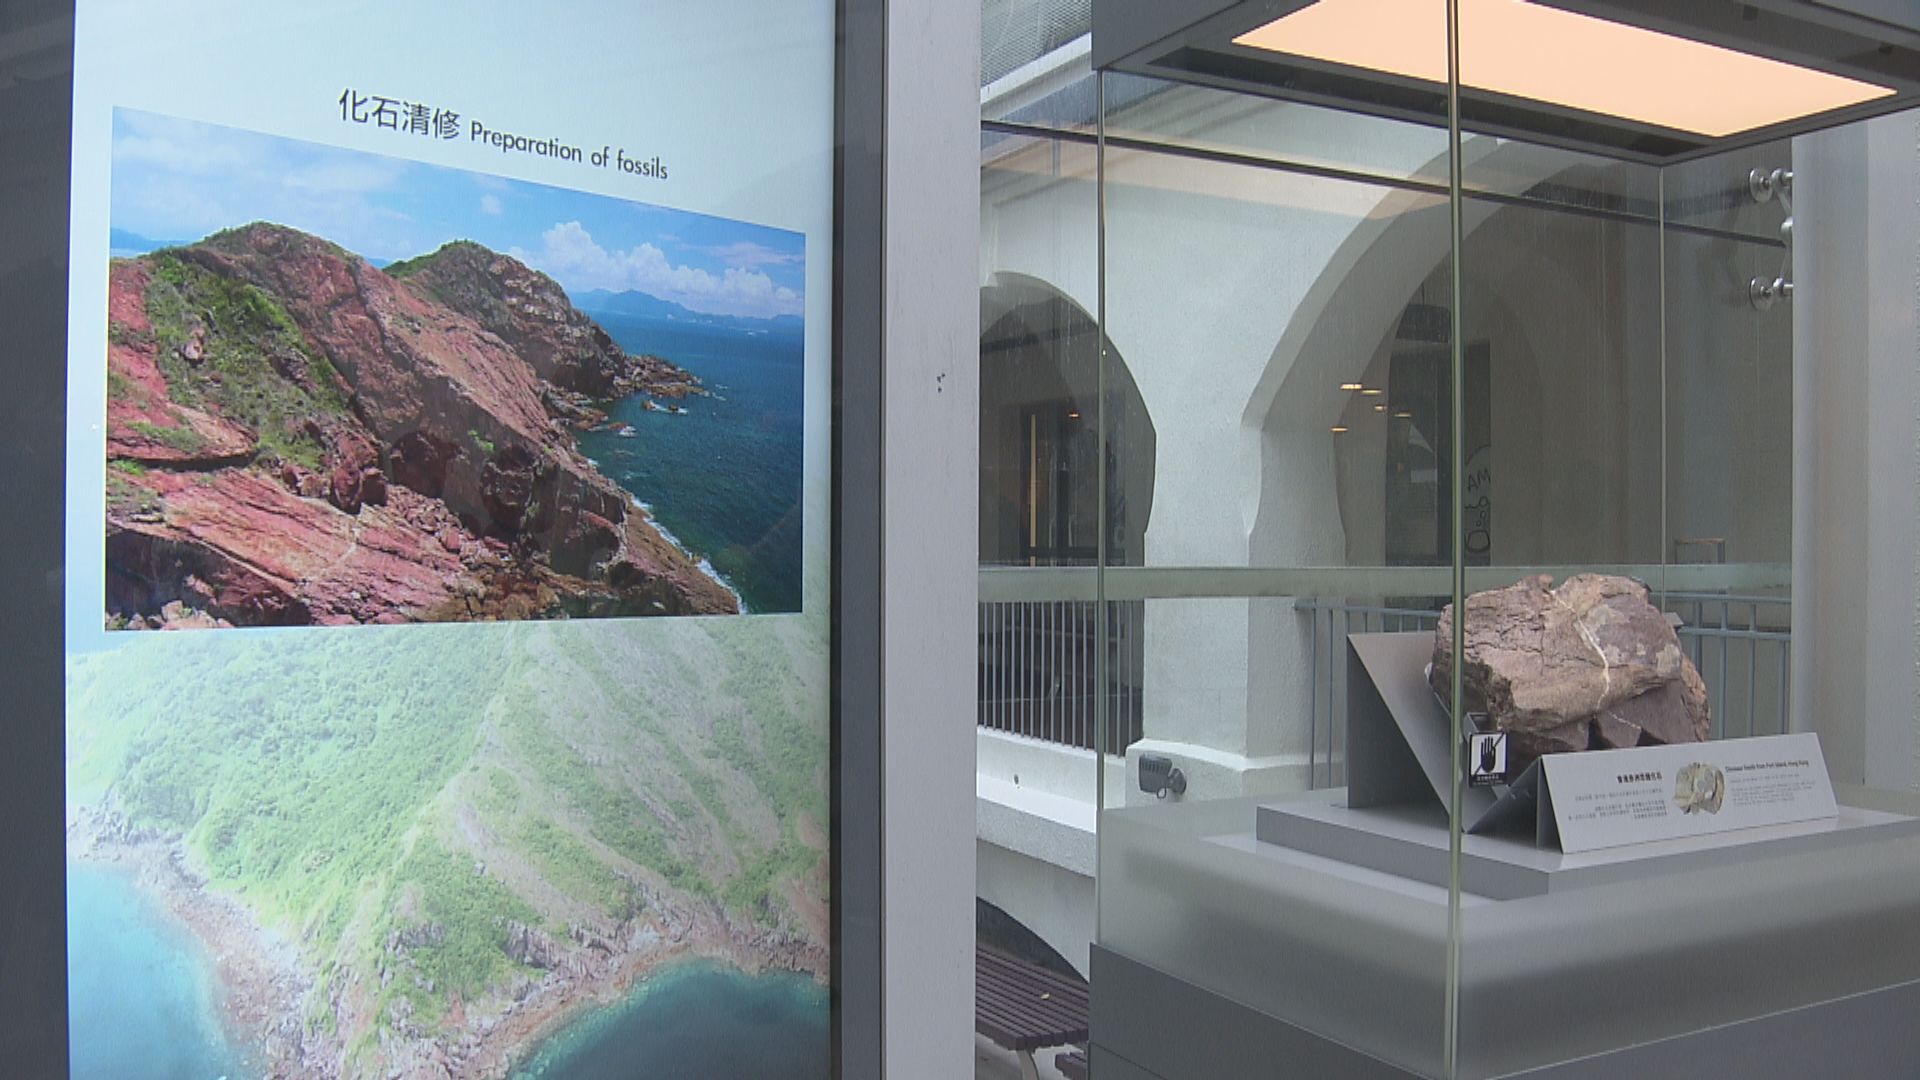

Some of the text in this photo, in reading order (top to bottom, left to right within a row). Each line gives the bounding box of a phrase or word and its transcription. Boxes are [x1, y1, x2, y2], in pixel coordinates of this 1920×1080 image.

[339, 88, 669, 180] 化石清修 Preparation of fossils
